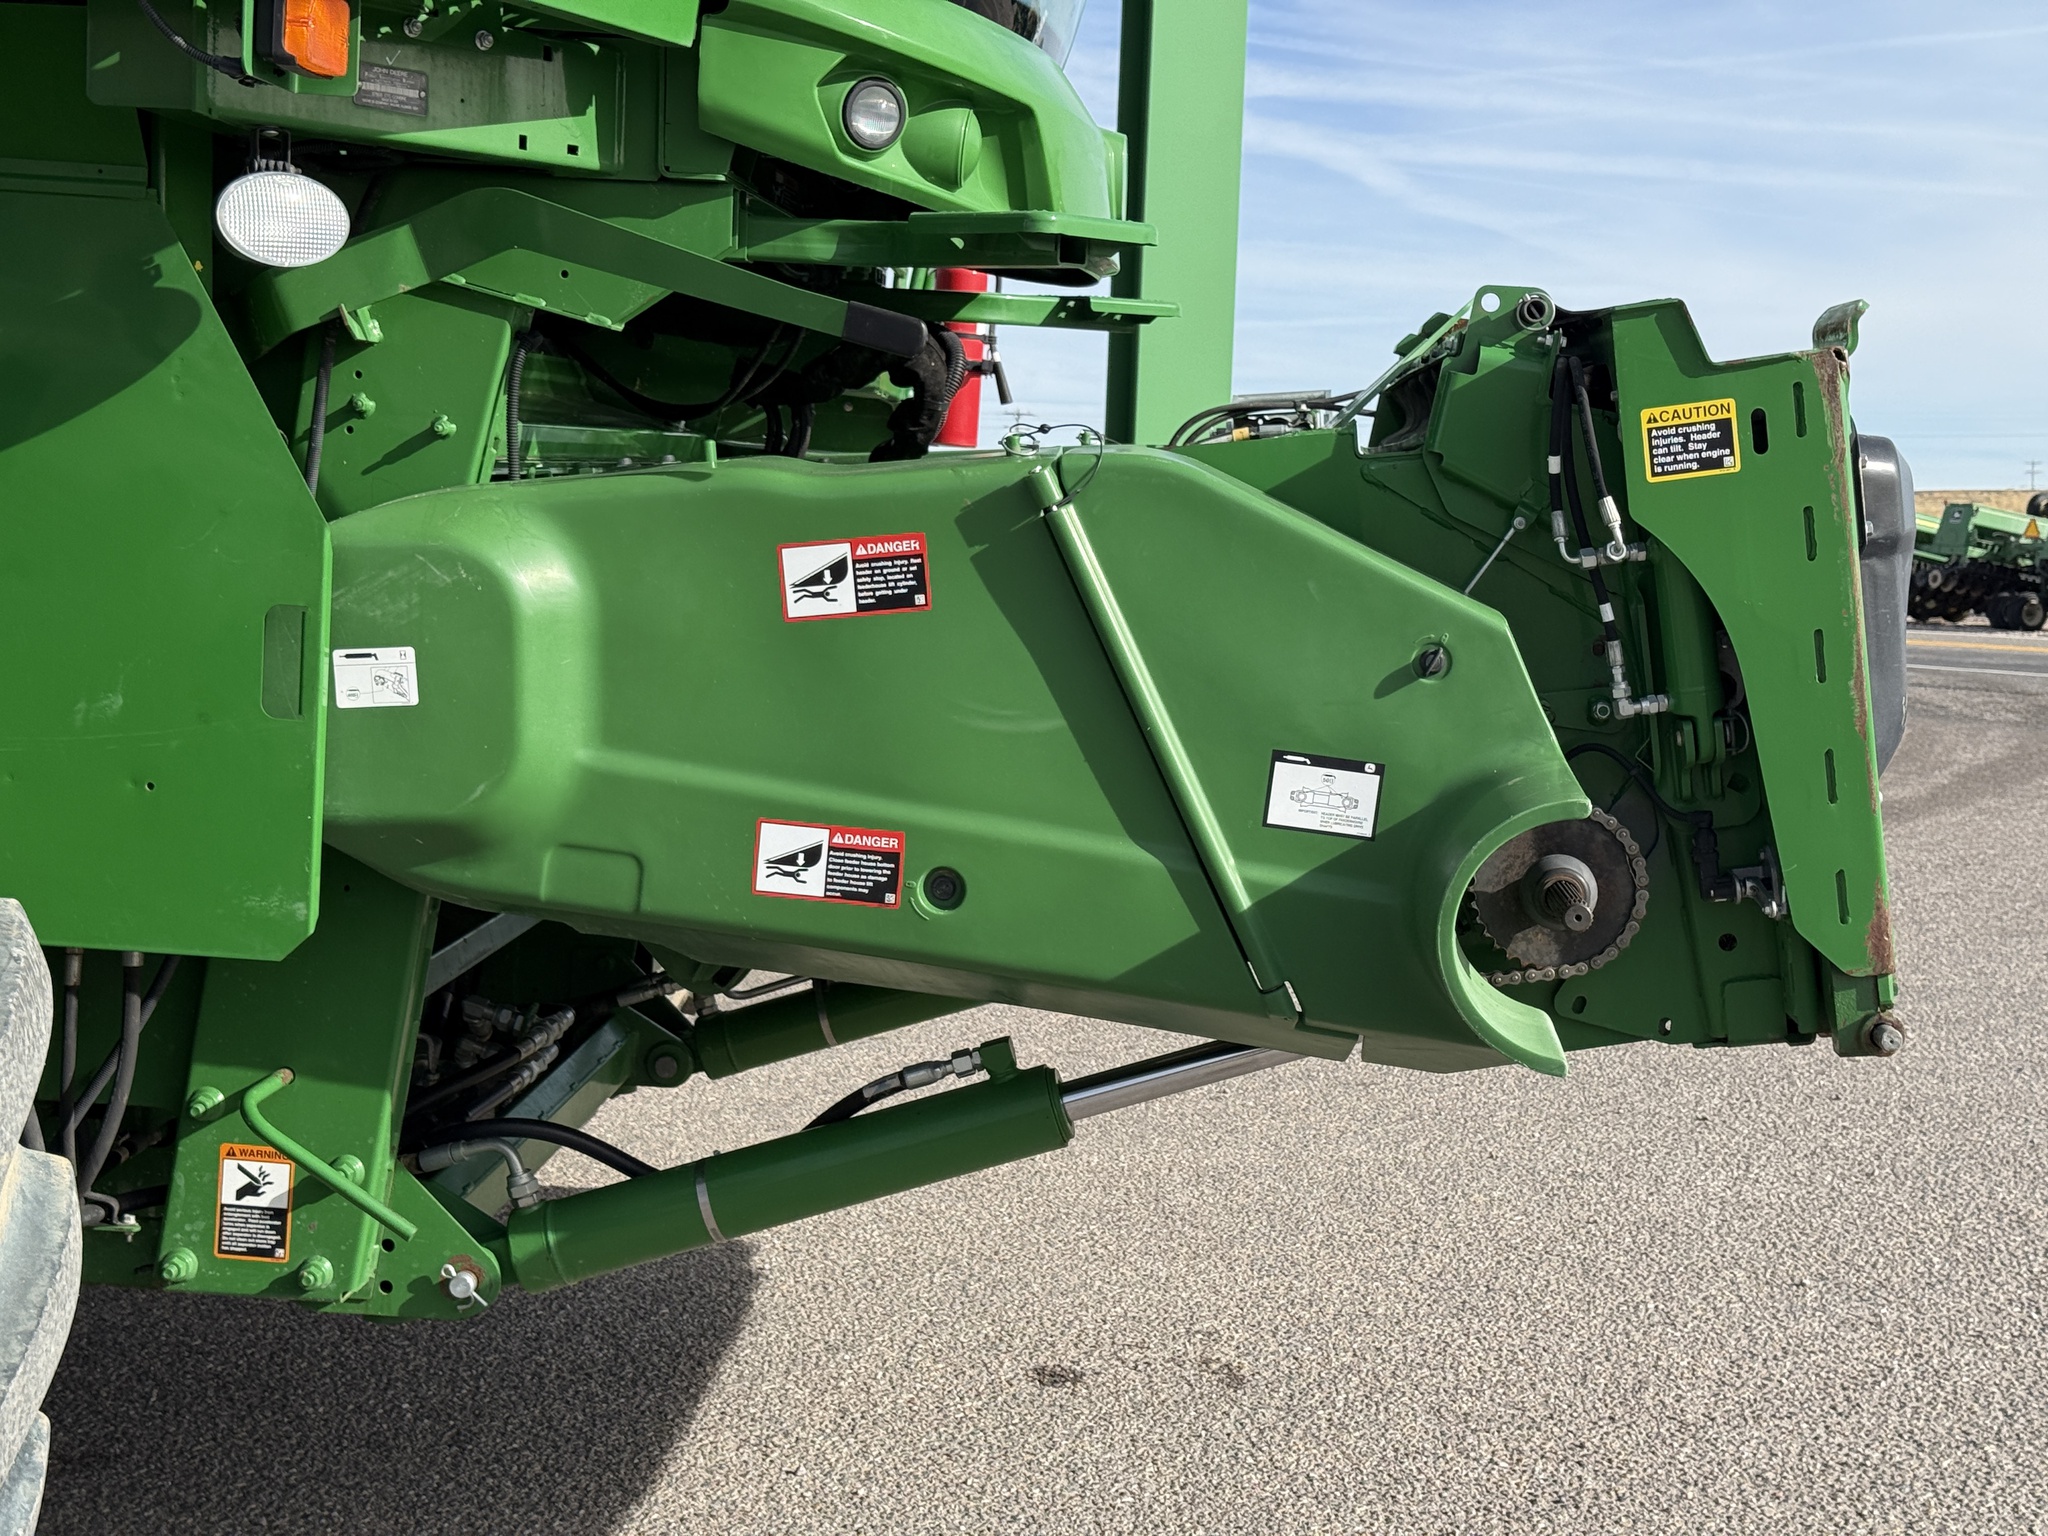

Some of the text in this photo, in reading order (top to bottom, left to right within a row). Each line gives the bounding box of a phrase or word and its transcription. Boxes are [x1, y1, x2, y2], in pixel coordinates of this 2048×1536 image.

[390, 69, 408, 77] DEERE
[1660, 402, 1730, 422] CAUTION
[1651, 423, 1715, 437] Avoid crushing
[1652, 432, 1721, 446] injuries. Header
[1653, 447, 1668, 455] can
[1670, 444, 1684, 452] tilt.
[1653, 448, 1730, 464] clear when engine
[1654, 462, 1700, 473] is running.
[867, 540, 920, 554] DANGER
[845, 834, 898, 848] DANGER
